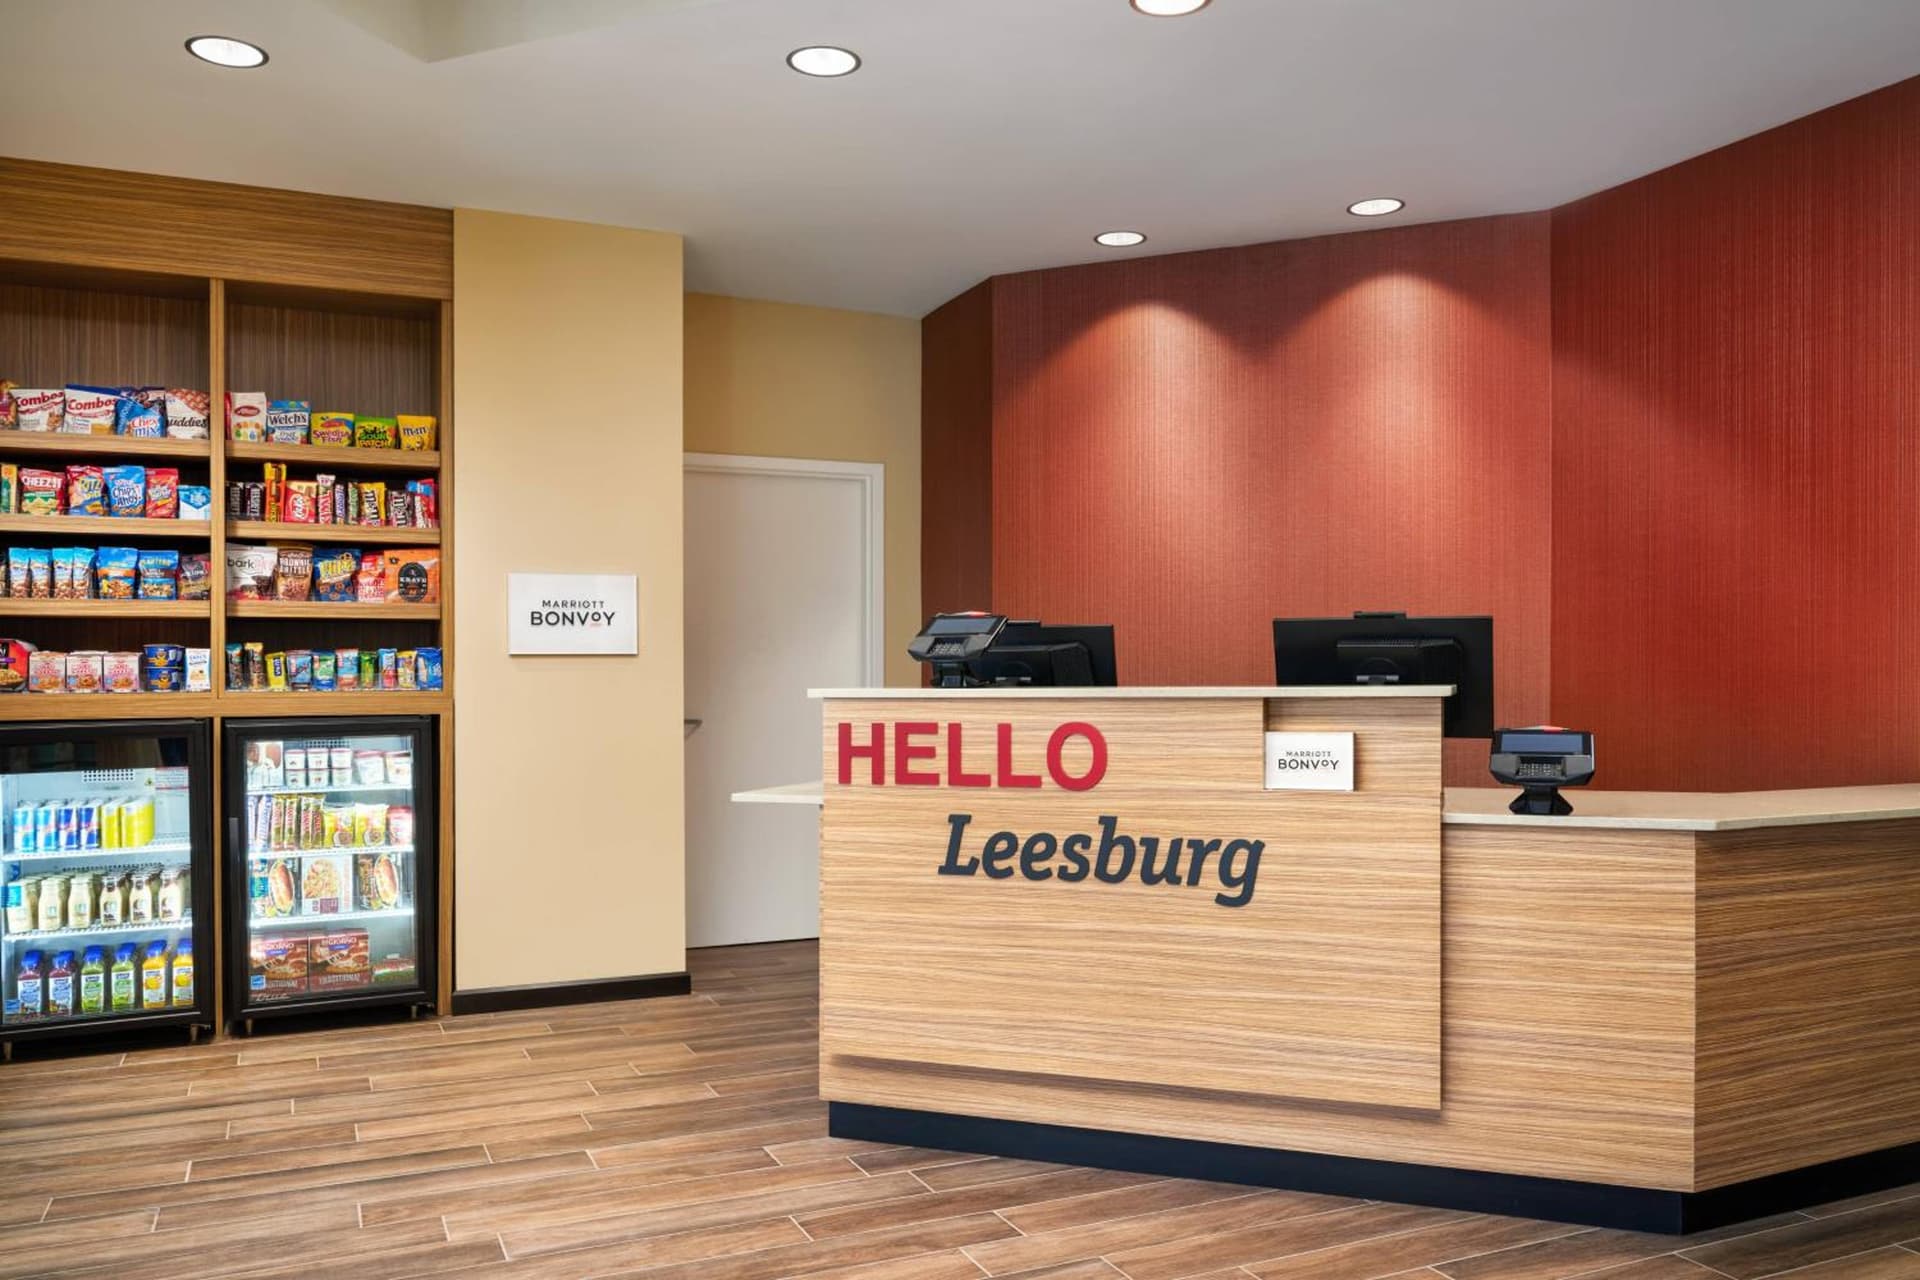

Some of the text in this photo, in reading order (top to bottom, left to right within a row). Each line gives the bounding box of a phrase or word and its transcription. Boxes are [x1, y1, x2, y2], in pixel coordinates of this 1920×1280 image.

[17, 390, 65, 408] Combos
[67, 396, 116, 411] Combos
[167, 416, 207, 429] uddies
[269, 413, 307, 426] Welch's
[542, 600, 605, 609] MARRIOTT
[838, 721, 1108, 791] HELLO
[938, 814, 1265, 907] Leesburg
